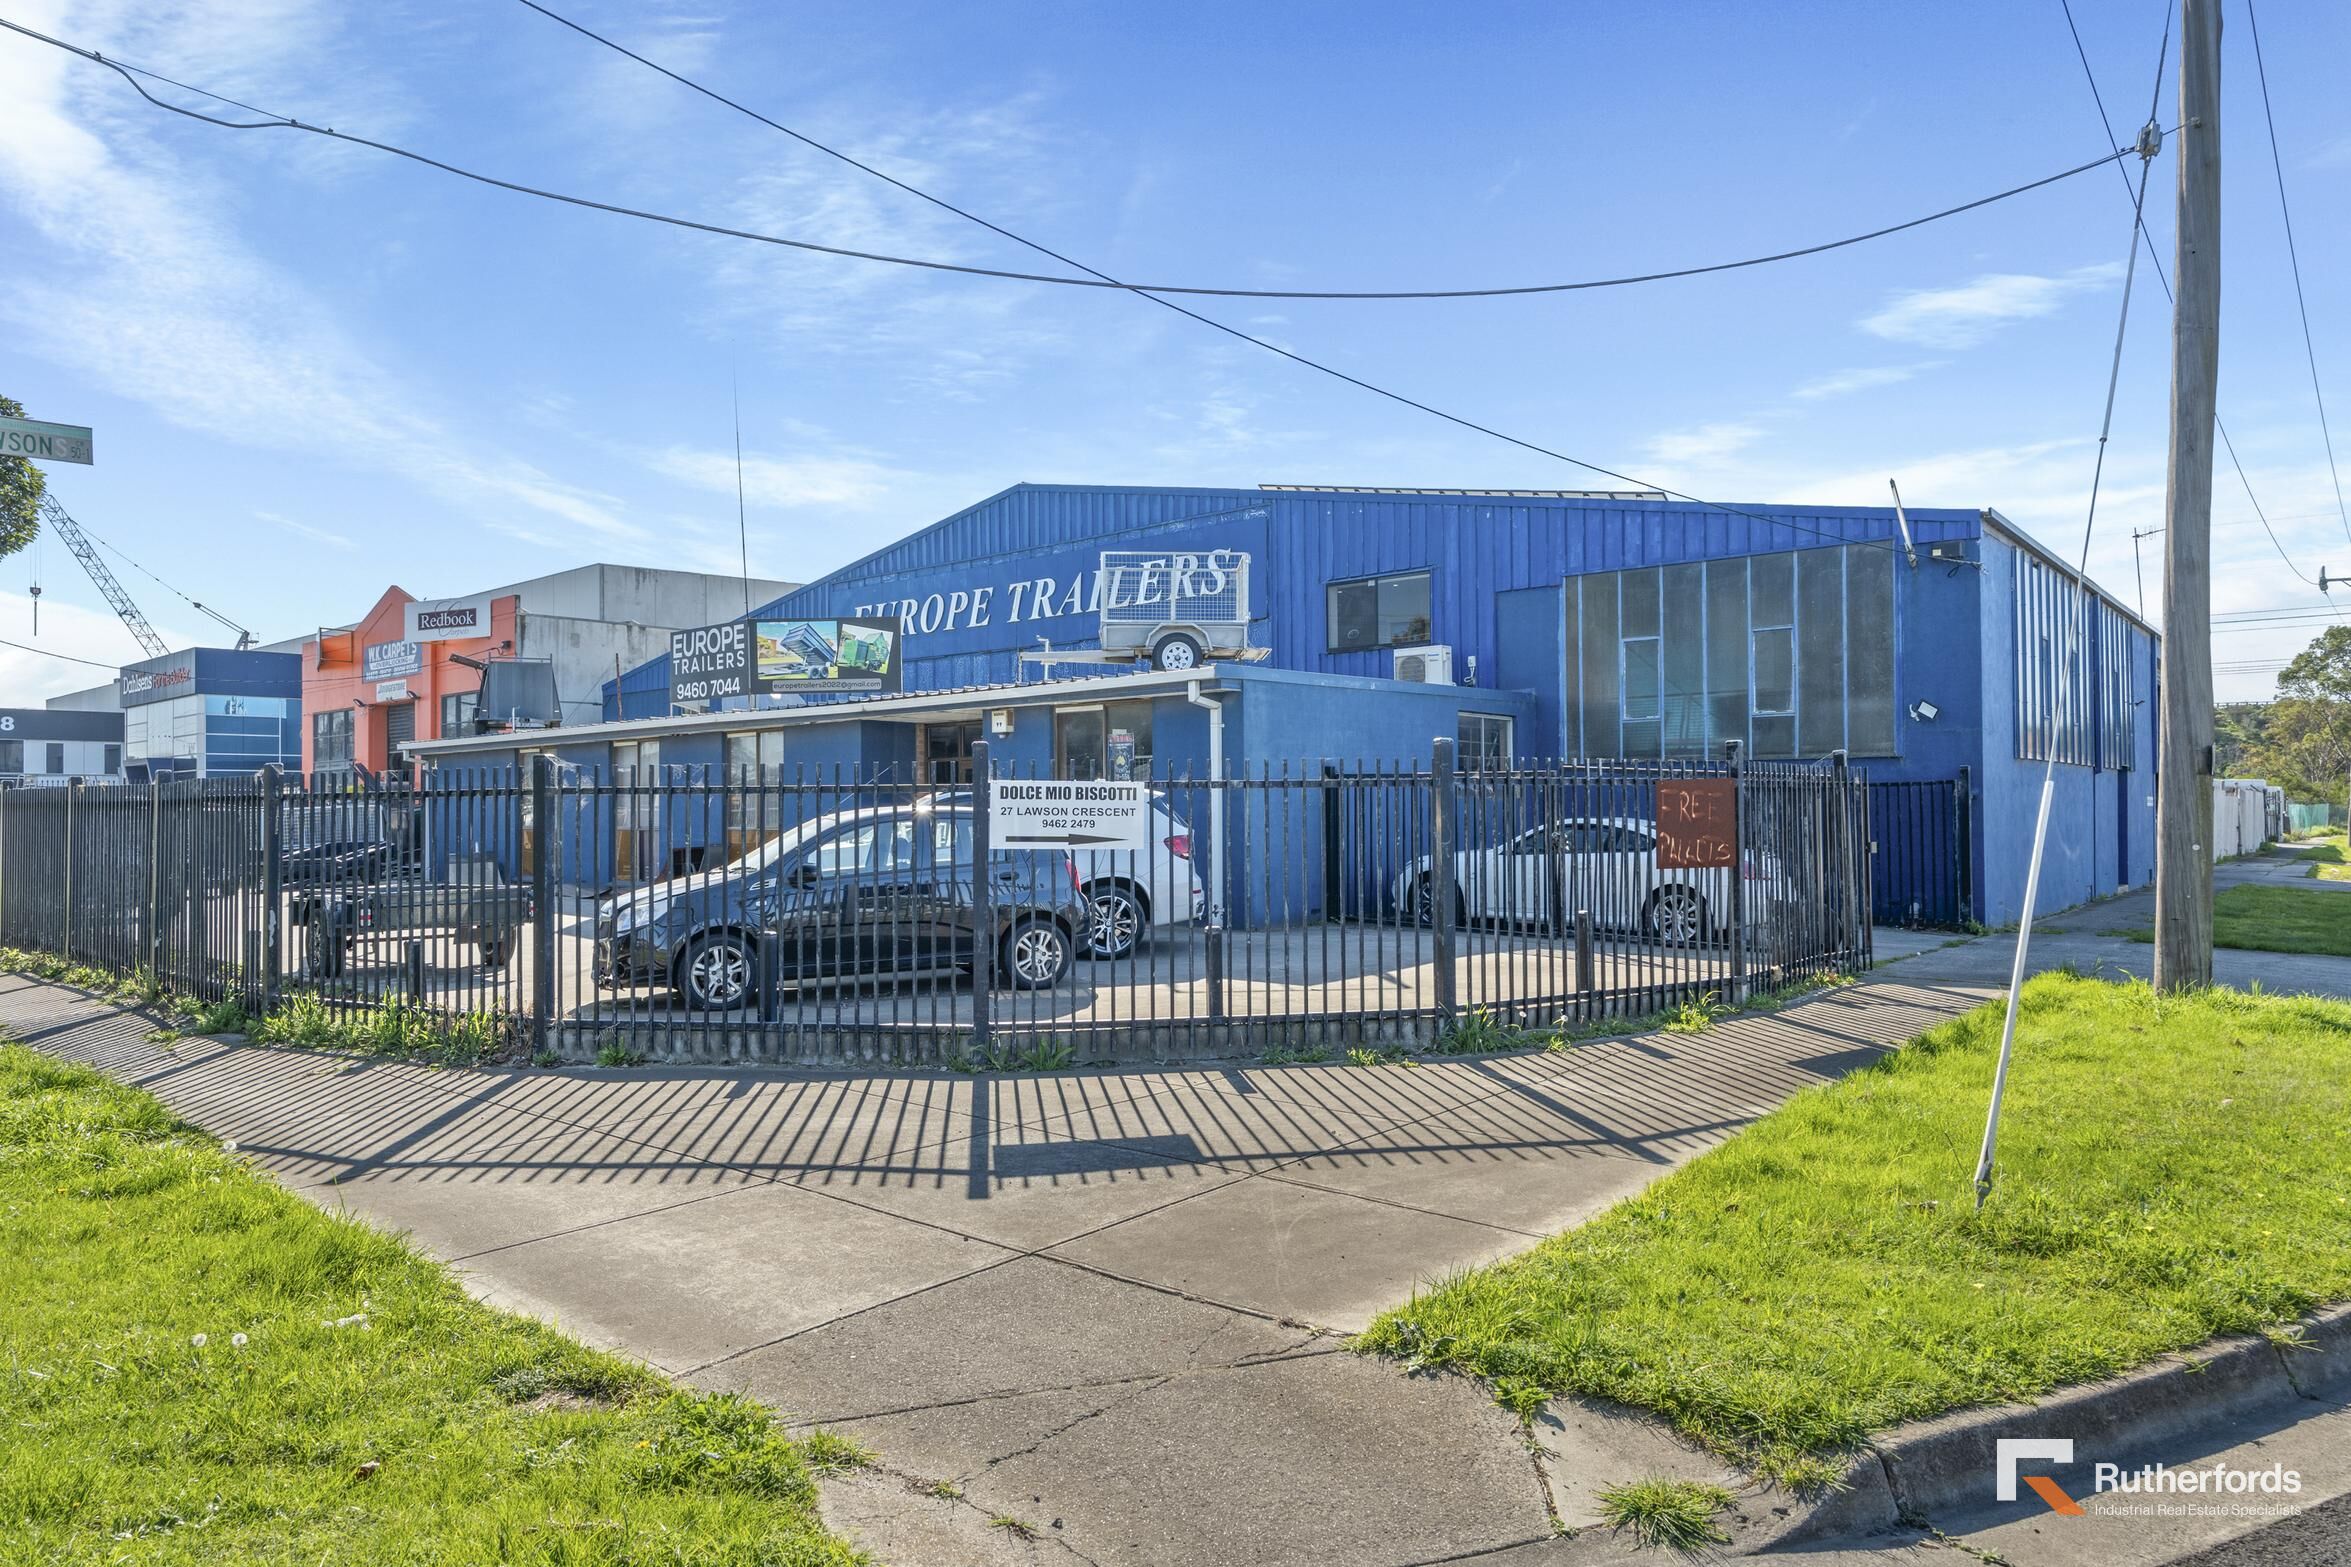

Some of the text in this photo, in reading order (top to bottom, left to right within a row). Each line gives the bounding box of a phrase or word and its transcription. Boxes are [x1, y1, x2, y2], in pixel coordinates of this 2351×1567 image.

[1007, 548, 1232, 623] TRAILERS
[420, 610, 474, 629] Redbook
[382, 641, 417, 660] CARPETS
[672, 624, 745, 659] EUROPE
[673, 650, 745, 675] TRAILERS
[677, 677, 741, 699] 9460 7044
[773, 681, 880, 690] europetrailers2022@gmail.com
[0, 716, 15, 731] 8
[1000, 785, 1137, 801] DOLCE MIO BISCOTTI
[1000, 807, 1136, 817] 27 LAWSON CRESCENT
[1660, 788, 1723, 822] FREE
[1042, 819, 1096, 828] 9462 2479
